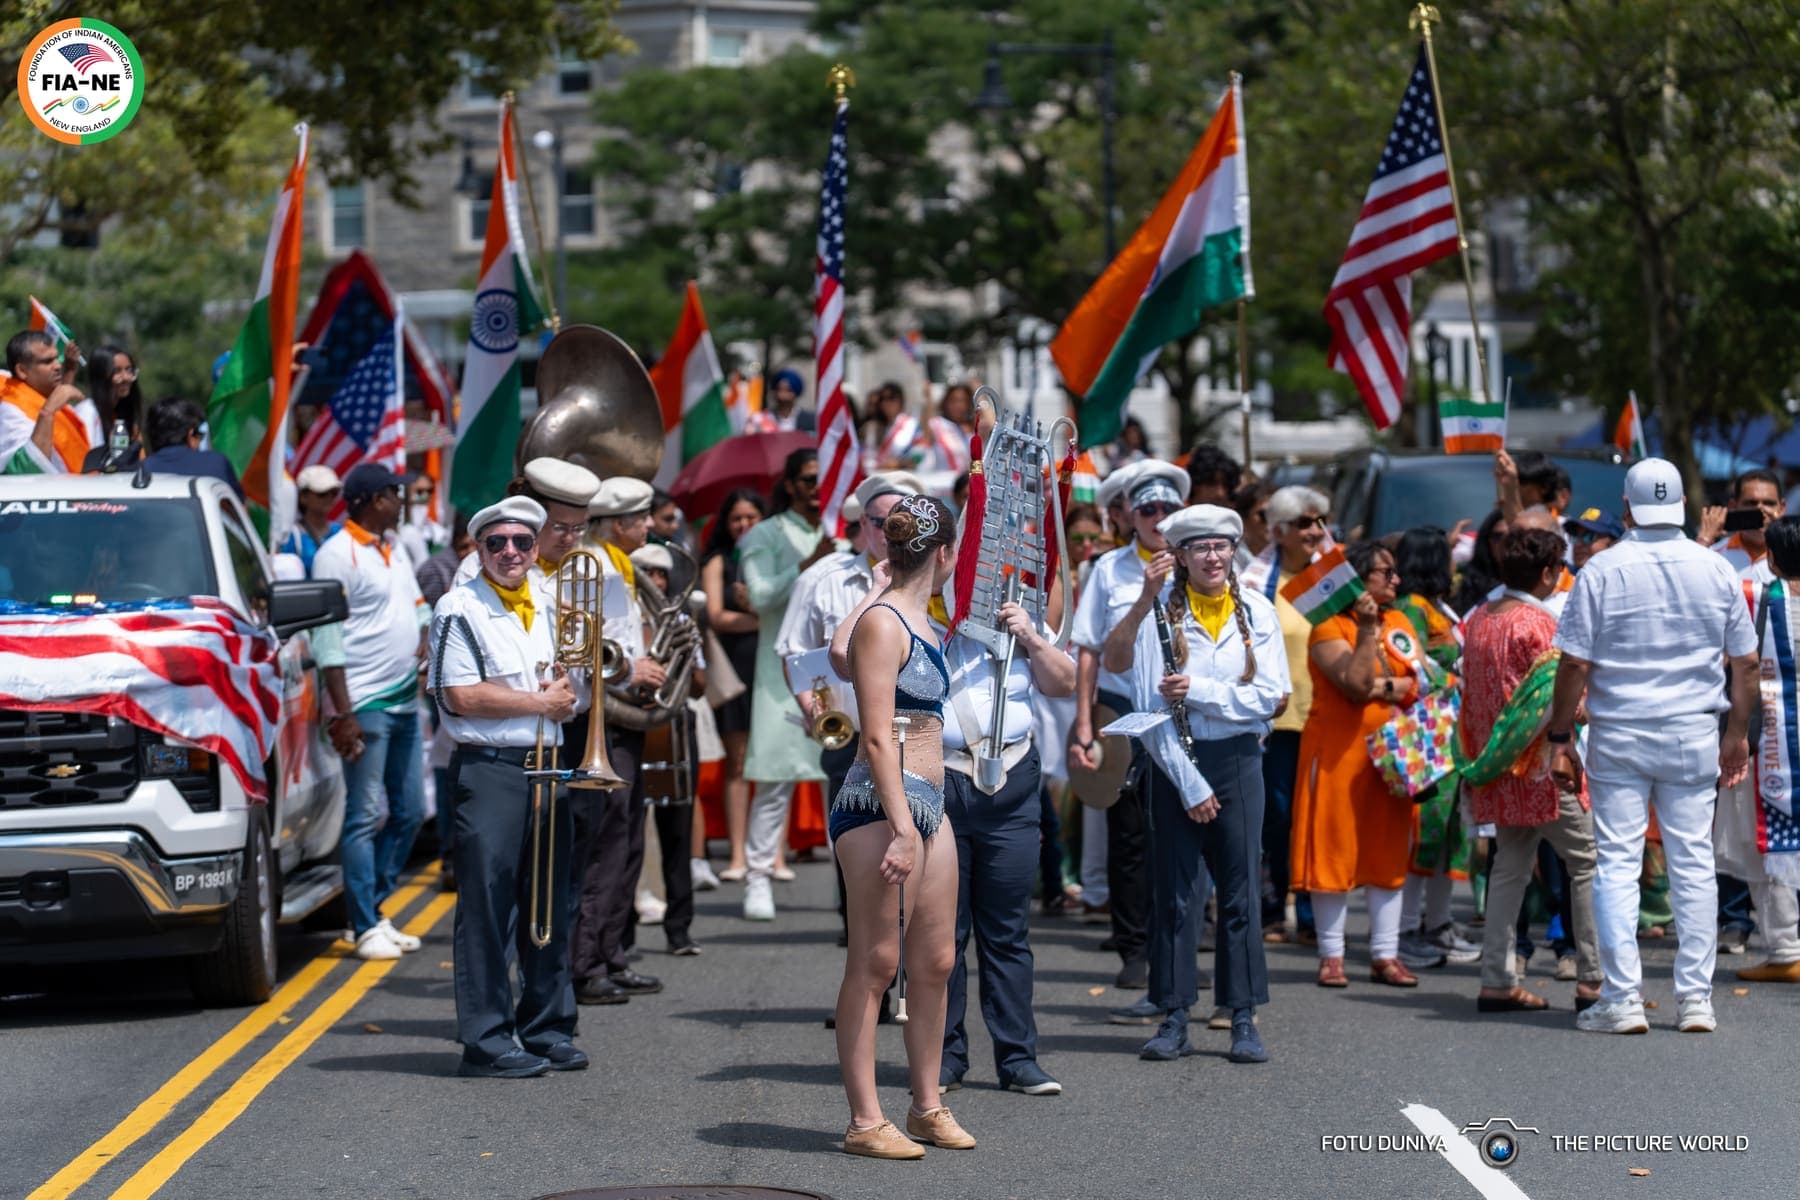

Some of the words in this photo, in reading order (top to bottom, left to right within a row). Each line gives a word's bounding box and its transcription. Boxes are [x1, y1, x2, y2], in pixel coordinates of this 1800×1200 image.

[0, 500, 79, 514] AUL
[1761, 690, 1780, 771] EXECUTIVE
[175, 875, 195, 891] BP
